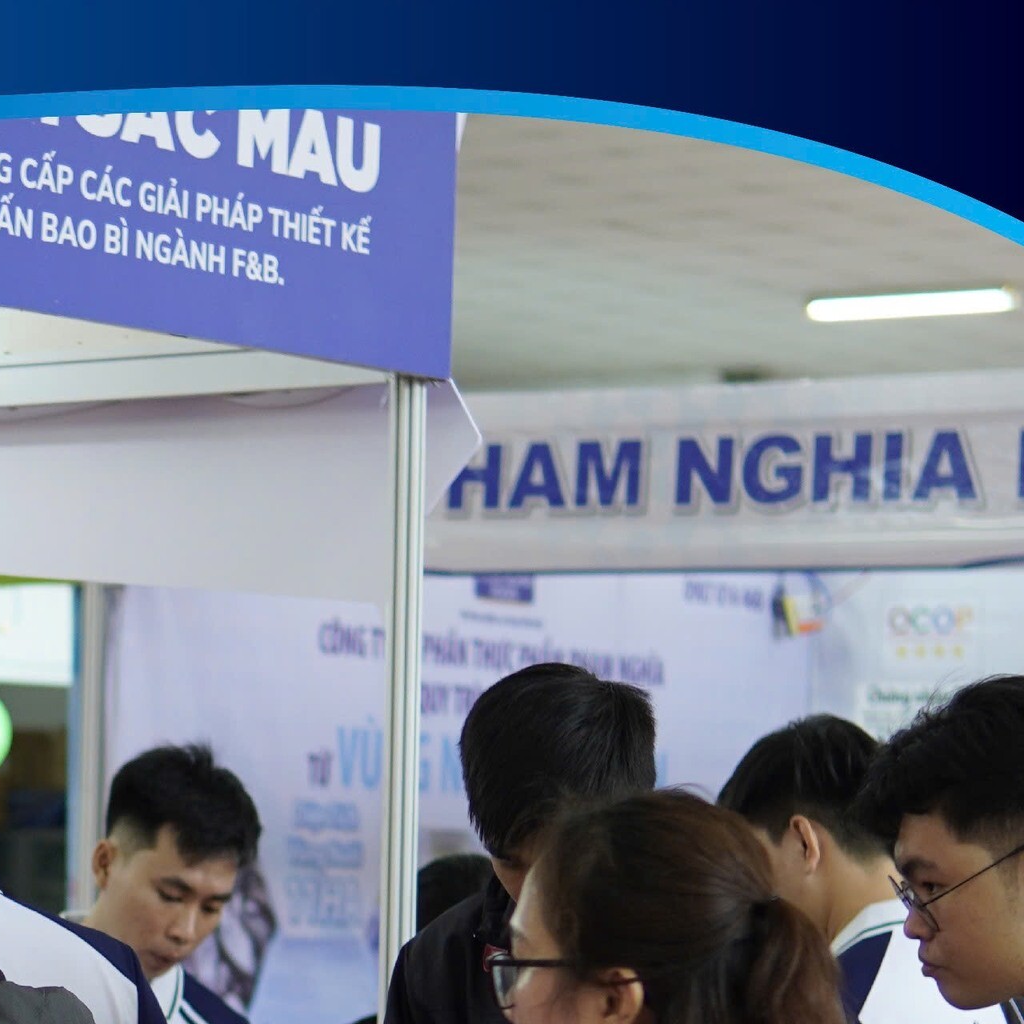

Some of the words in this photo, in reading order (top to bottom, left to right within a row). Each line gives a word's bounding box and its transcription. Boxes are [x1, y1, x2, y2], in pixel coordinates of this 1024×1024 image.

[20, 151, 74, 194] CẤP
[80, 165, 132, 207] CÁC
[139, 178, 189, 219] GIẢI
[196, 192, 263, 232] PHÁP
[268, 205, 336, 247] THIẾT
[342, 215, 373, 255] KẾ
[41, 210, 97, 250] BAO
[104, 217, 129, 256] BÌ
[136, 228, 226, 275] NGÀNH
[233, 248, 285, 286] F&B.
[675, 430, 977, 505] NGHIA
